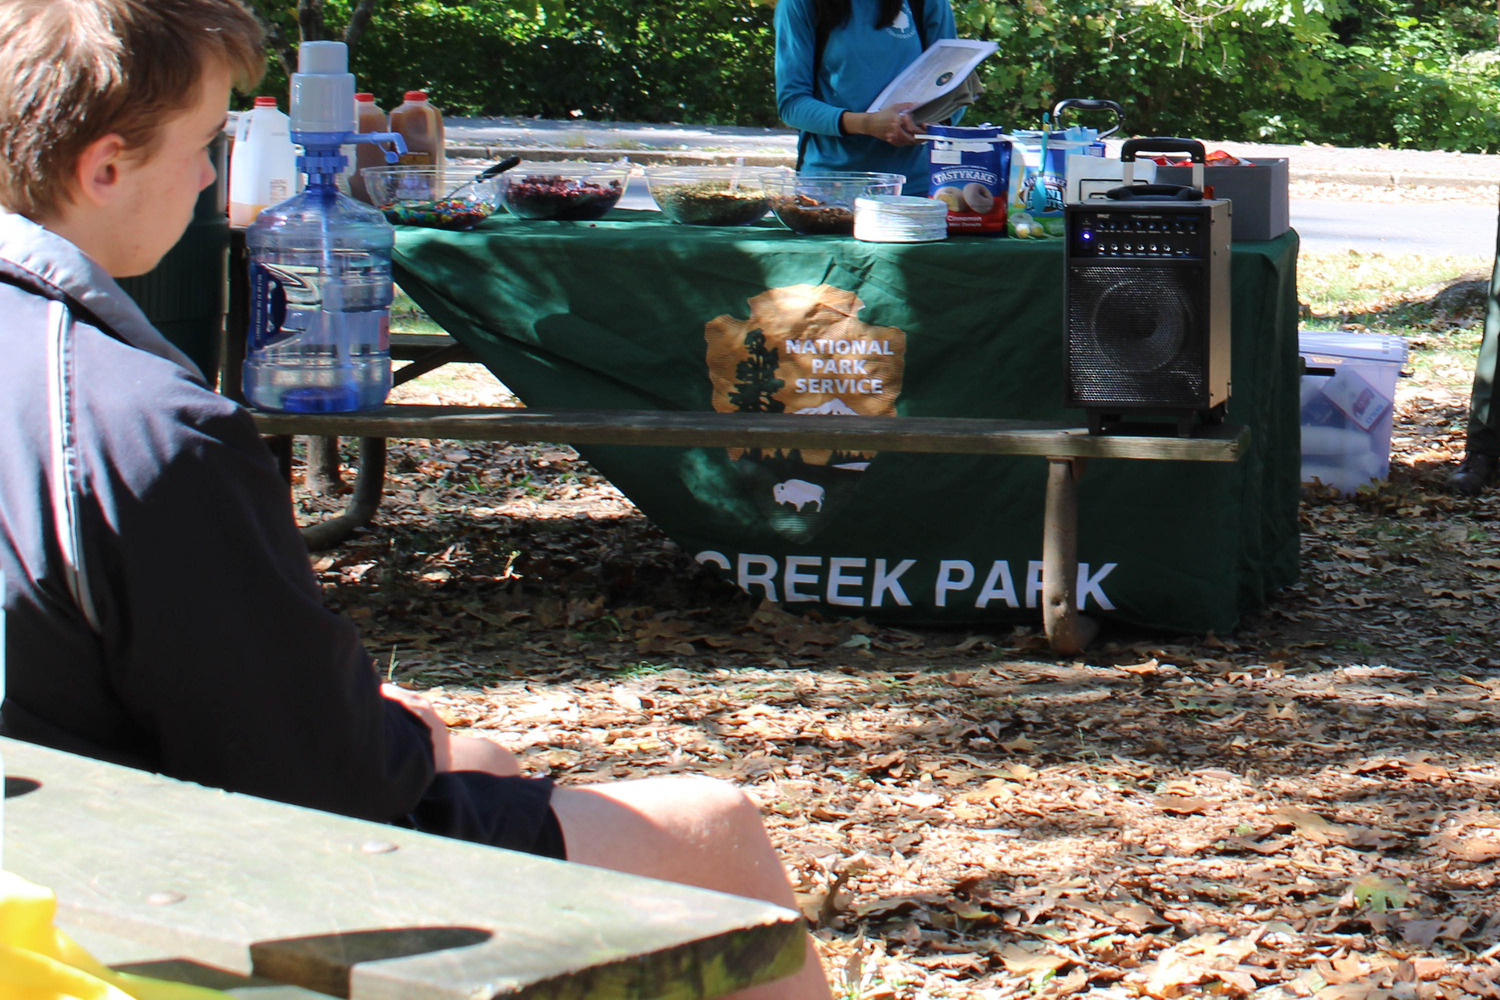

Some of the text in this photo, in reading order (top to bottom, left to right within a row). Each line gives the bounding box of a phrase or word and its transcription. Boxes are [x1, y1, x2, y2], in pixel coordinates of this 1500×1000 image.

[932, 170, 994, 186] TASTYKAKE
[1023, 175, 1068, 190] TASKAKE
[785, 339, 894, 356] NATIONAL
[811, 358, 868, 375] PARK
[795, 378, 884, 394] SERVICE
